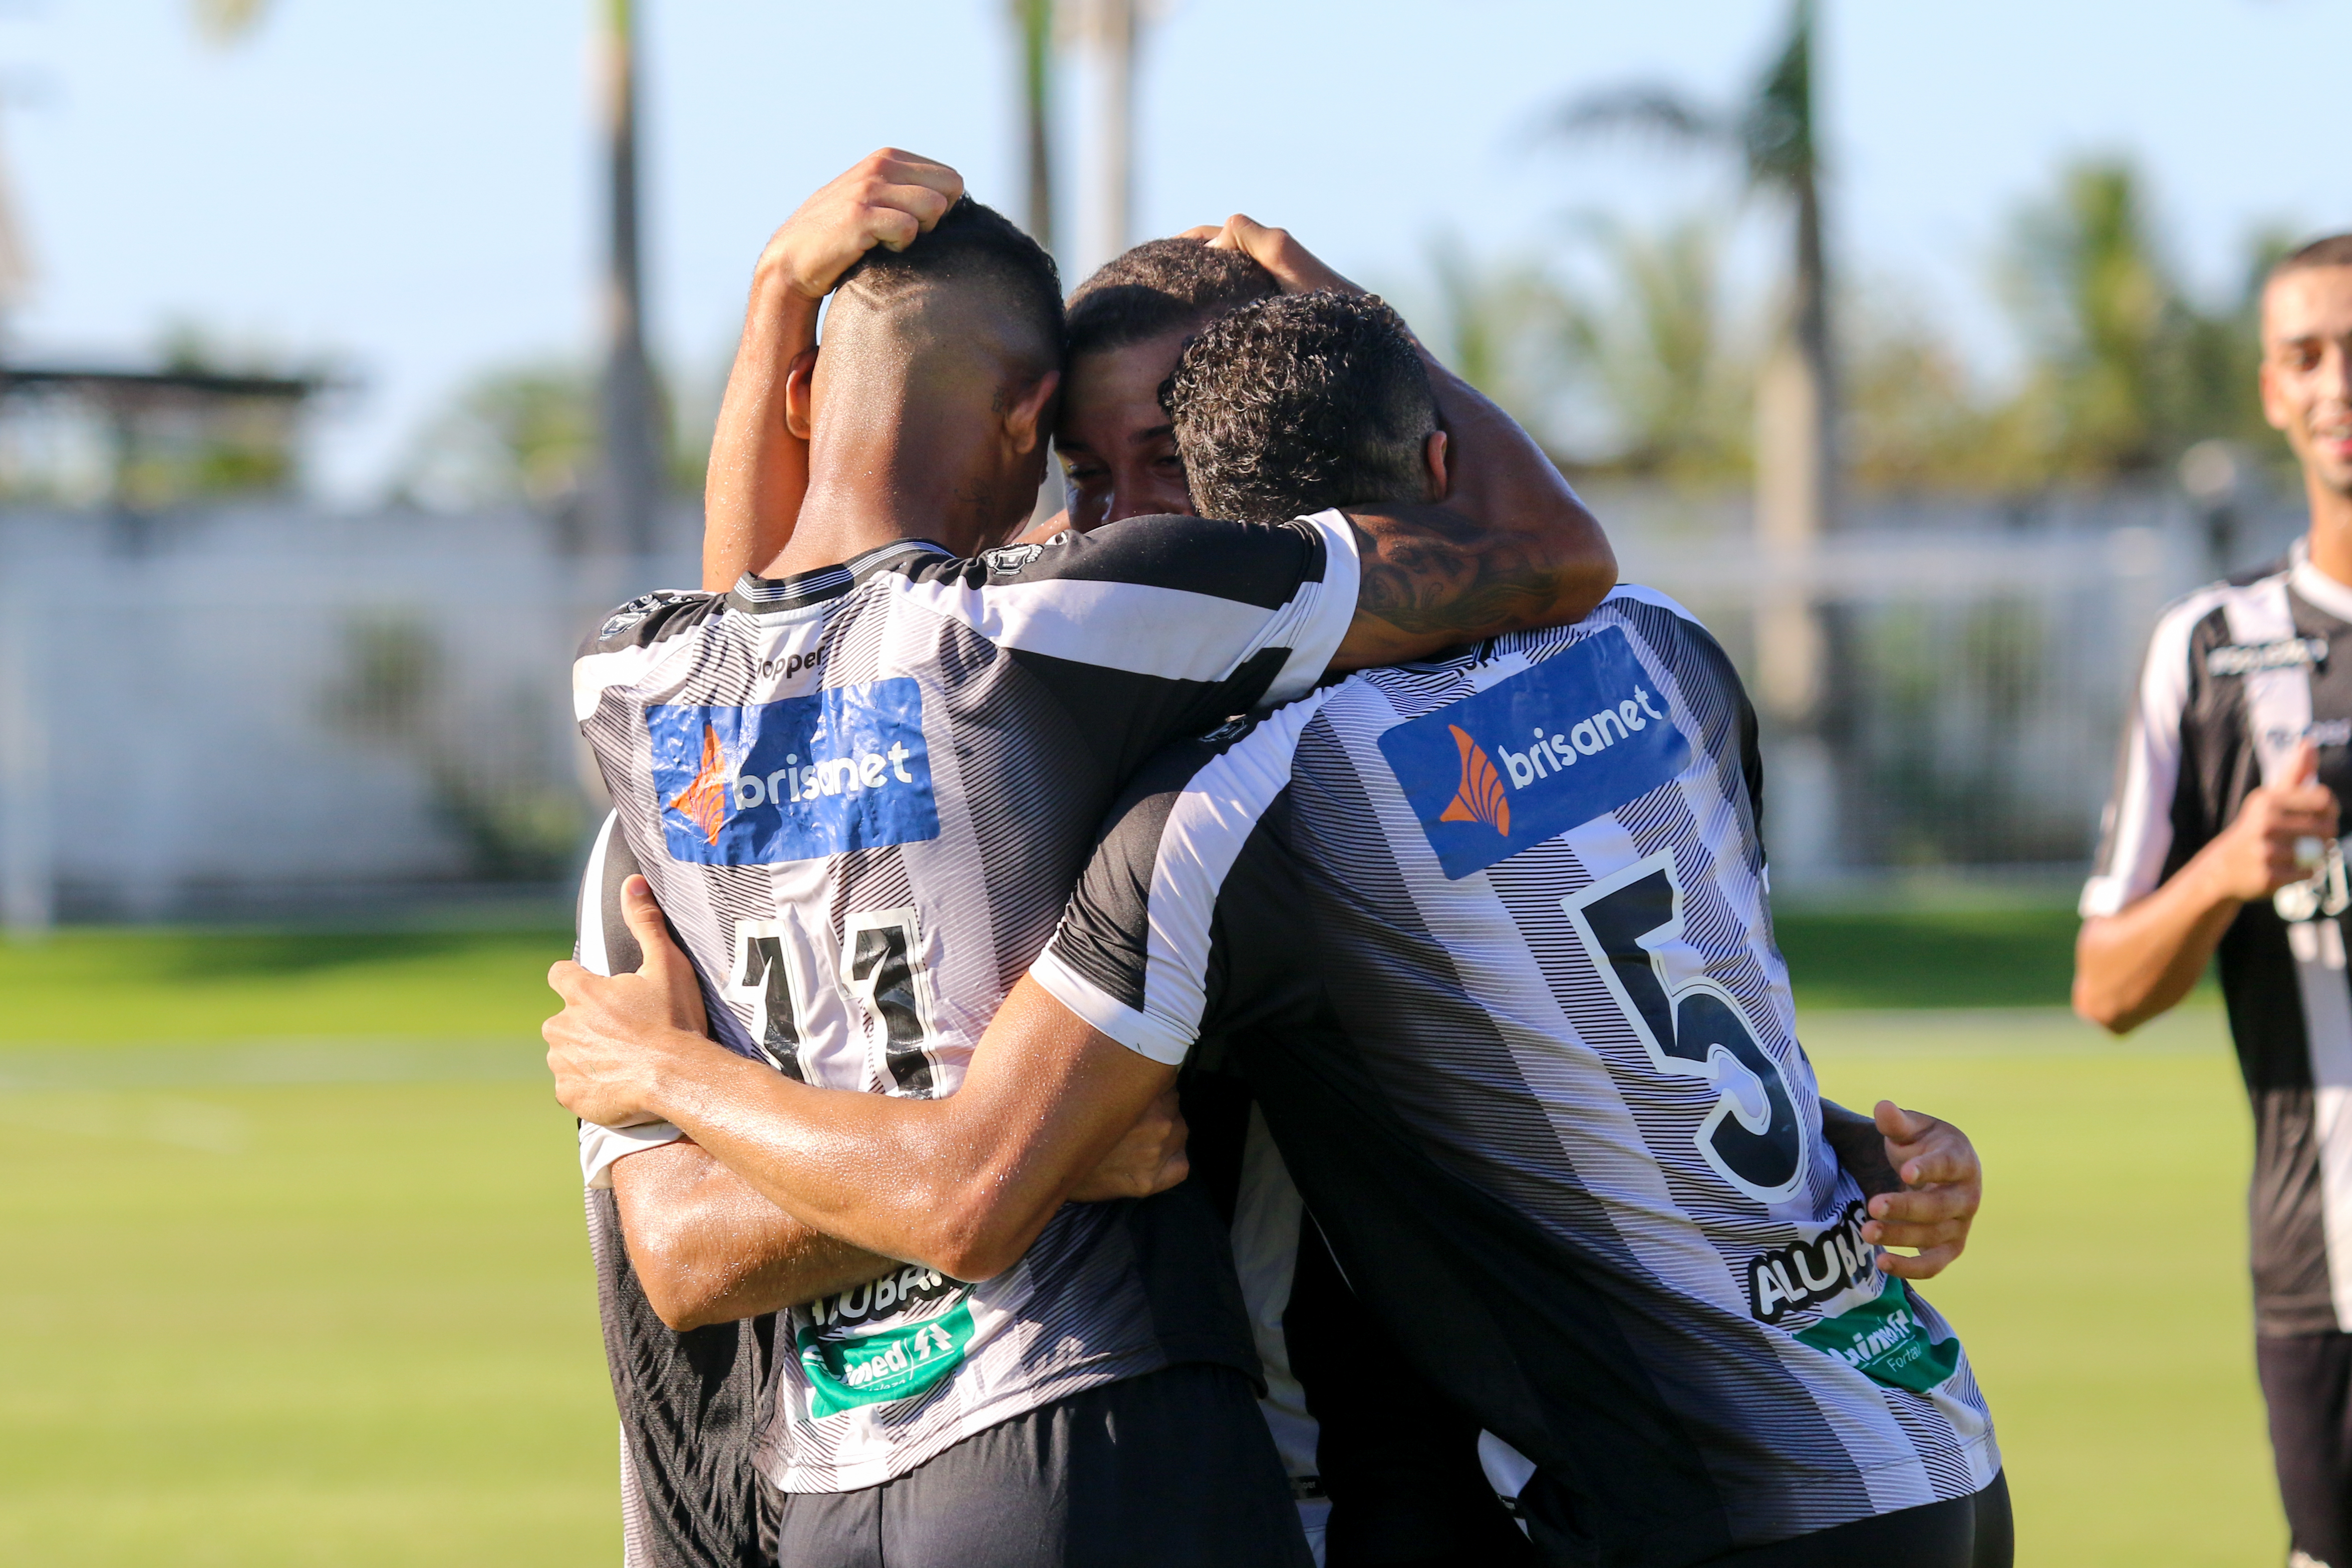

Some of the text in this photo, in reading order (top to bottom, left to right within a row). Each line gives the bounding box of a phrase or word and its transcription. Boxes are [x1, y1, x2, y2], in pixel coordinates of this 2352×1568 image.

[732, 741, 912, 811] brisanet
[1498, 684, 1663, 790] brisanet
[1559, 845, 1809, 1204] 5
